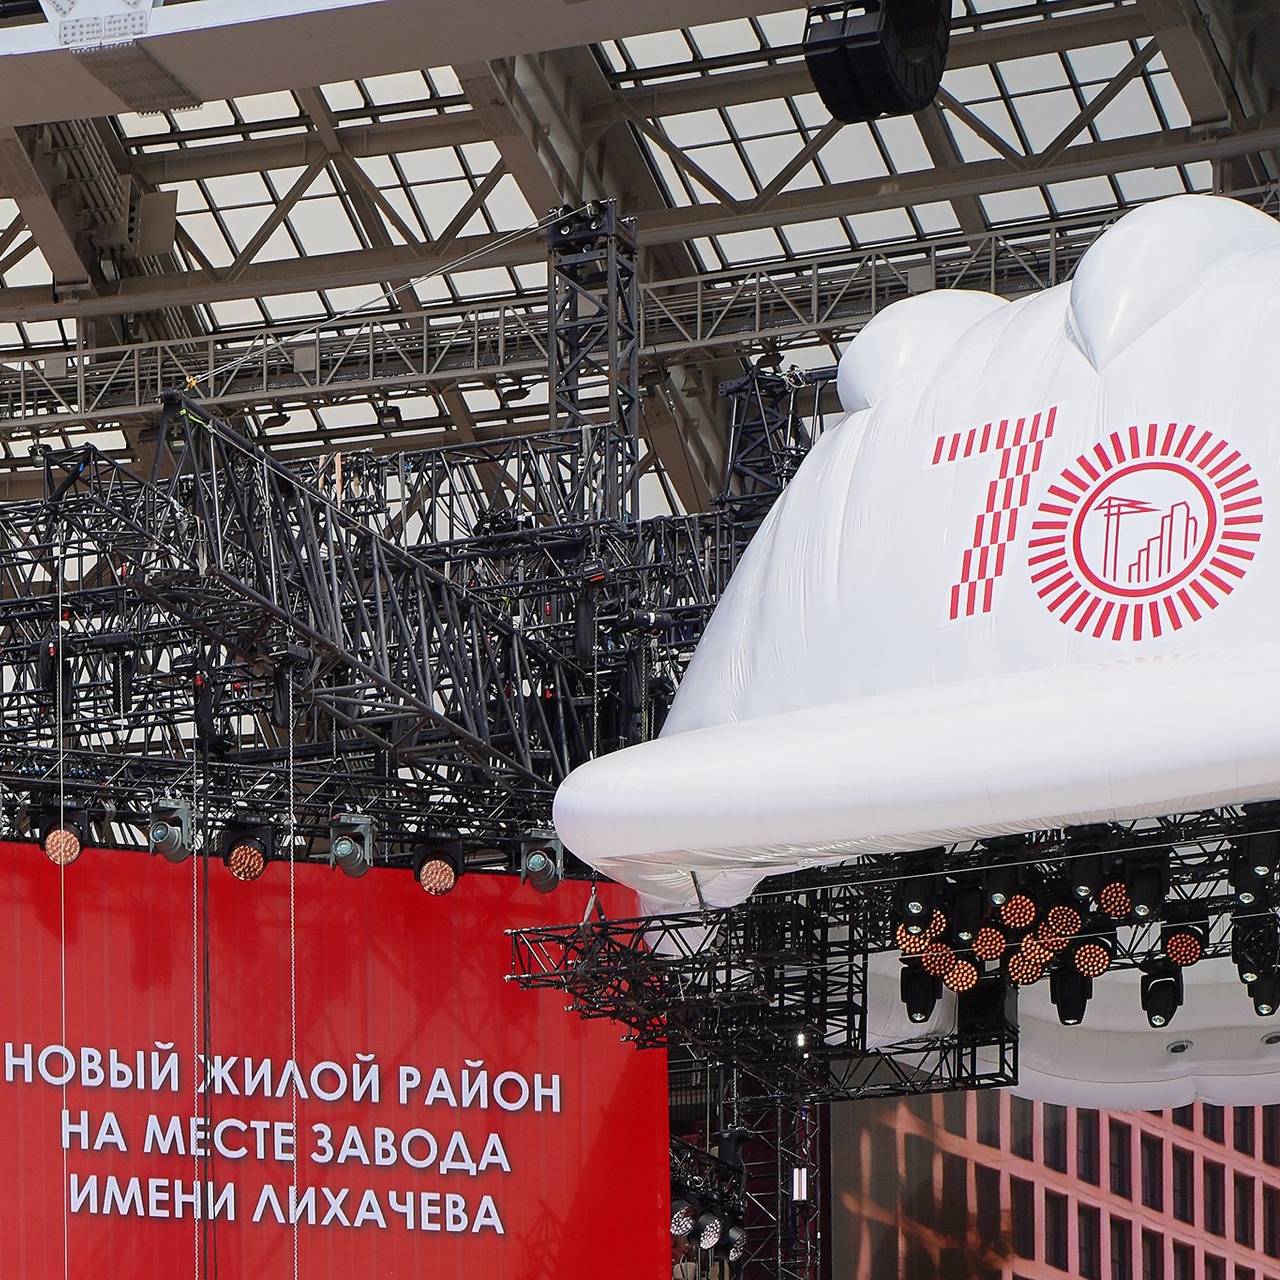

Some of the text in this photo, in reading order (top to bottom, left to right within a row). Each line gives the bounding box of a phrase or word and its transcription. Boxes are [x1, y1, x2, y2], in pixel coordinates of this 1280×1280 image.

[5, 1042, 561, 1113] НОВЫЙ ЖИЛОЙ РАЙОН
[61, 1109, 511, 1176] НА МЕСТЕ ЗАВОДА
[70, 1174, 505, 1234] ИМЕНИ ЛИХАЧЕВА
